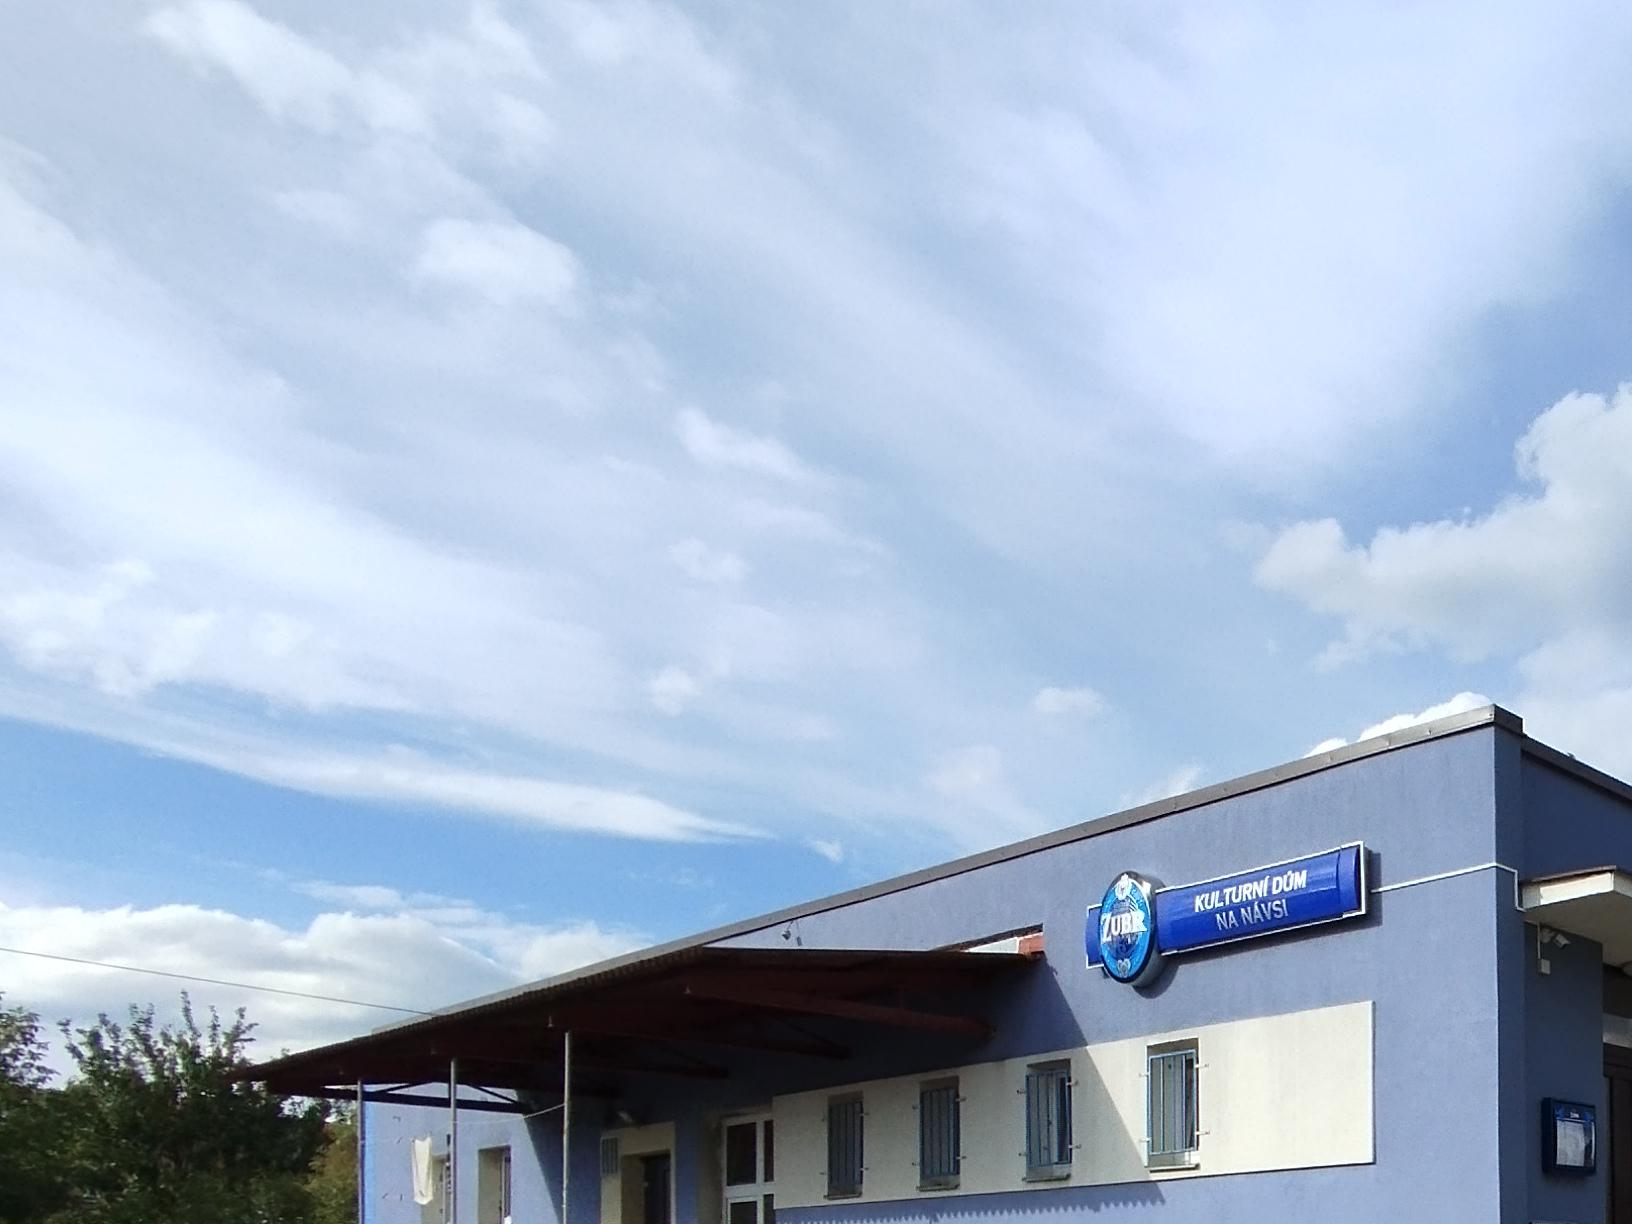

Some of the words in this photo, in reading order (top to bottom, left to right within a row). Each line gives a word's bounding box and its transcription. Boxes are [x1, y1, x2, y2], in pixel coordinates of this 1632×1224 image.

[1195, 876, 1269, 912] KULTURNÍ
[1272, 870, 1307, 895] DŮM
[1101, 907, 1148, 944] ZUBR
[1216, 911, 1238, 930] NA
[1241, 899, 1288, 925] NÁVSI
